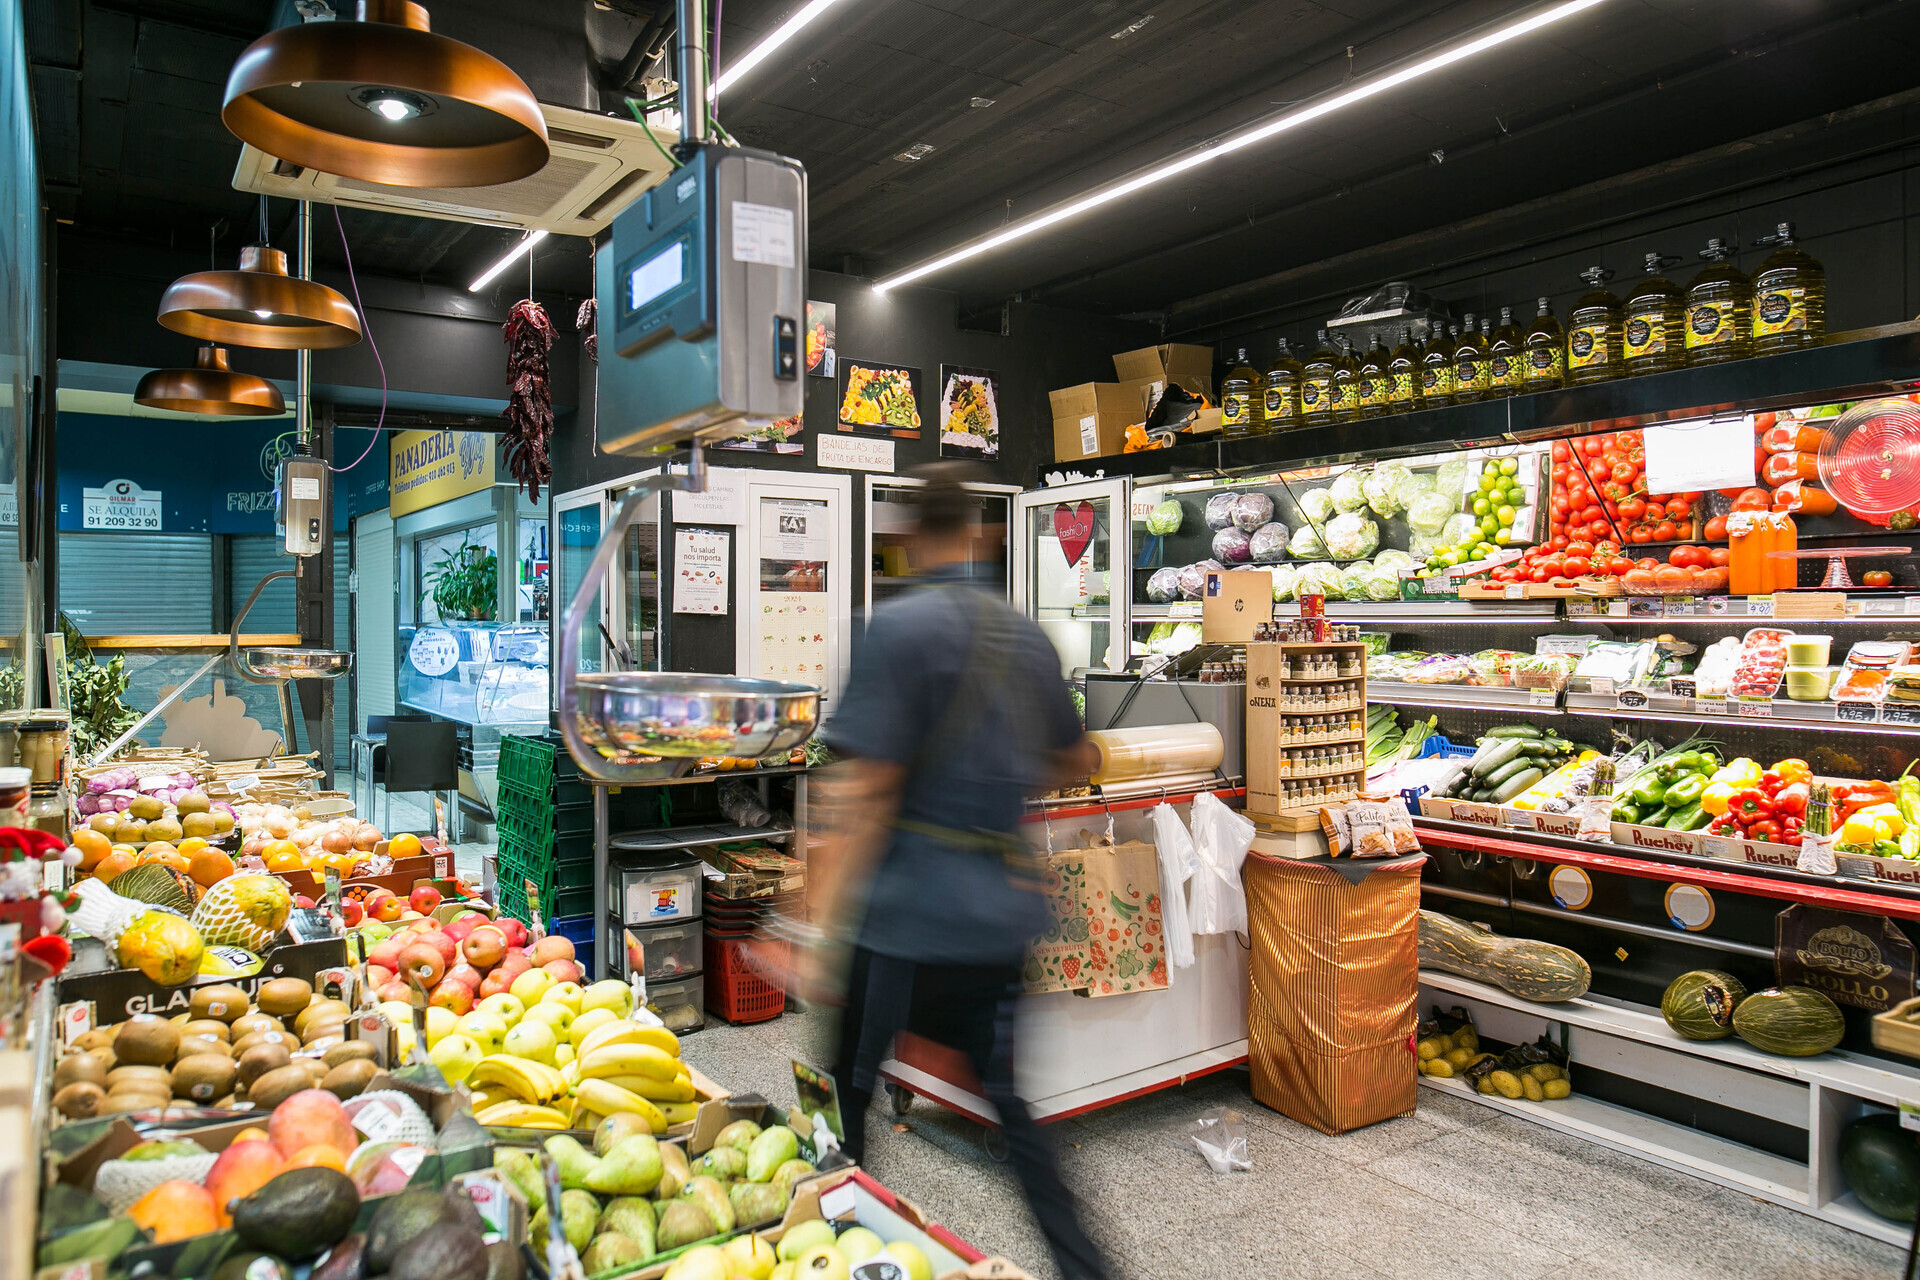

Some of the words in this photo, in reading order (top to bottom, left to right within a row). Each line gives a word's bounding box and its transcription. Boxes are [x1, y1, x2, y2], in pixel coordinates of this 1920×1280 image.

[822, 437, 867, 452] BANDEJAS
[872, 444, 885, 453] DE
[821, 452, 844, 462] FRUTA
[846, 455, 856, 463] DE
[858, 456, 892, 466] ENCARGO
[88, 505, 101, 515] SE
[105, 506, 157, 517] ALQUILA
[88, 517, 101, 525] 91
[105, 517, 126, 526] 209
[128, 518, 141, 527] 32
[144, 518, 158, 527] 90
[690, 545, 698, 553] Tu
[699, 546, 716, 554] salud
[697, 553, 722, 562] importa
[1356, 810, 1386, 823] Palitos
[1632, 829, 1694, 855] Ruchey
[1821, 942, 1867, 961] BOLLO
[1803, 971, 1889, 1001] BOLLO
